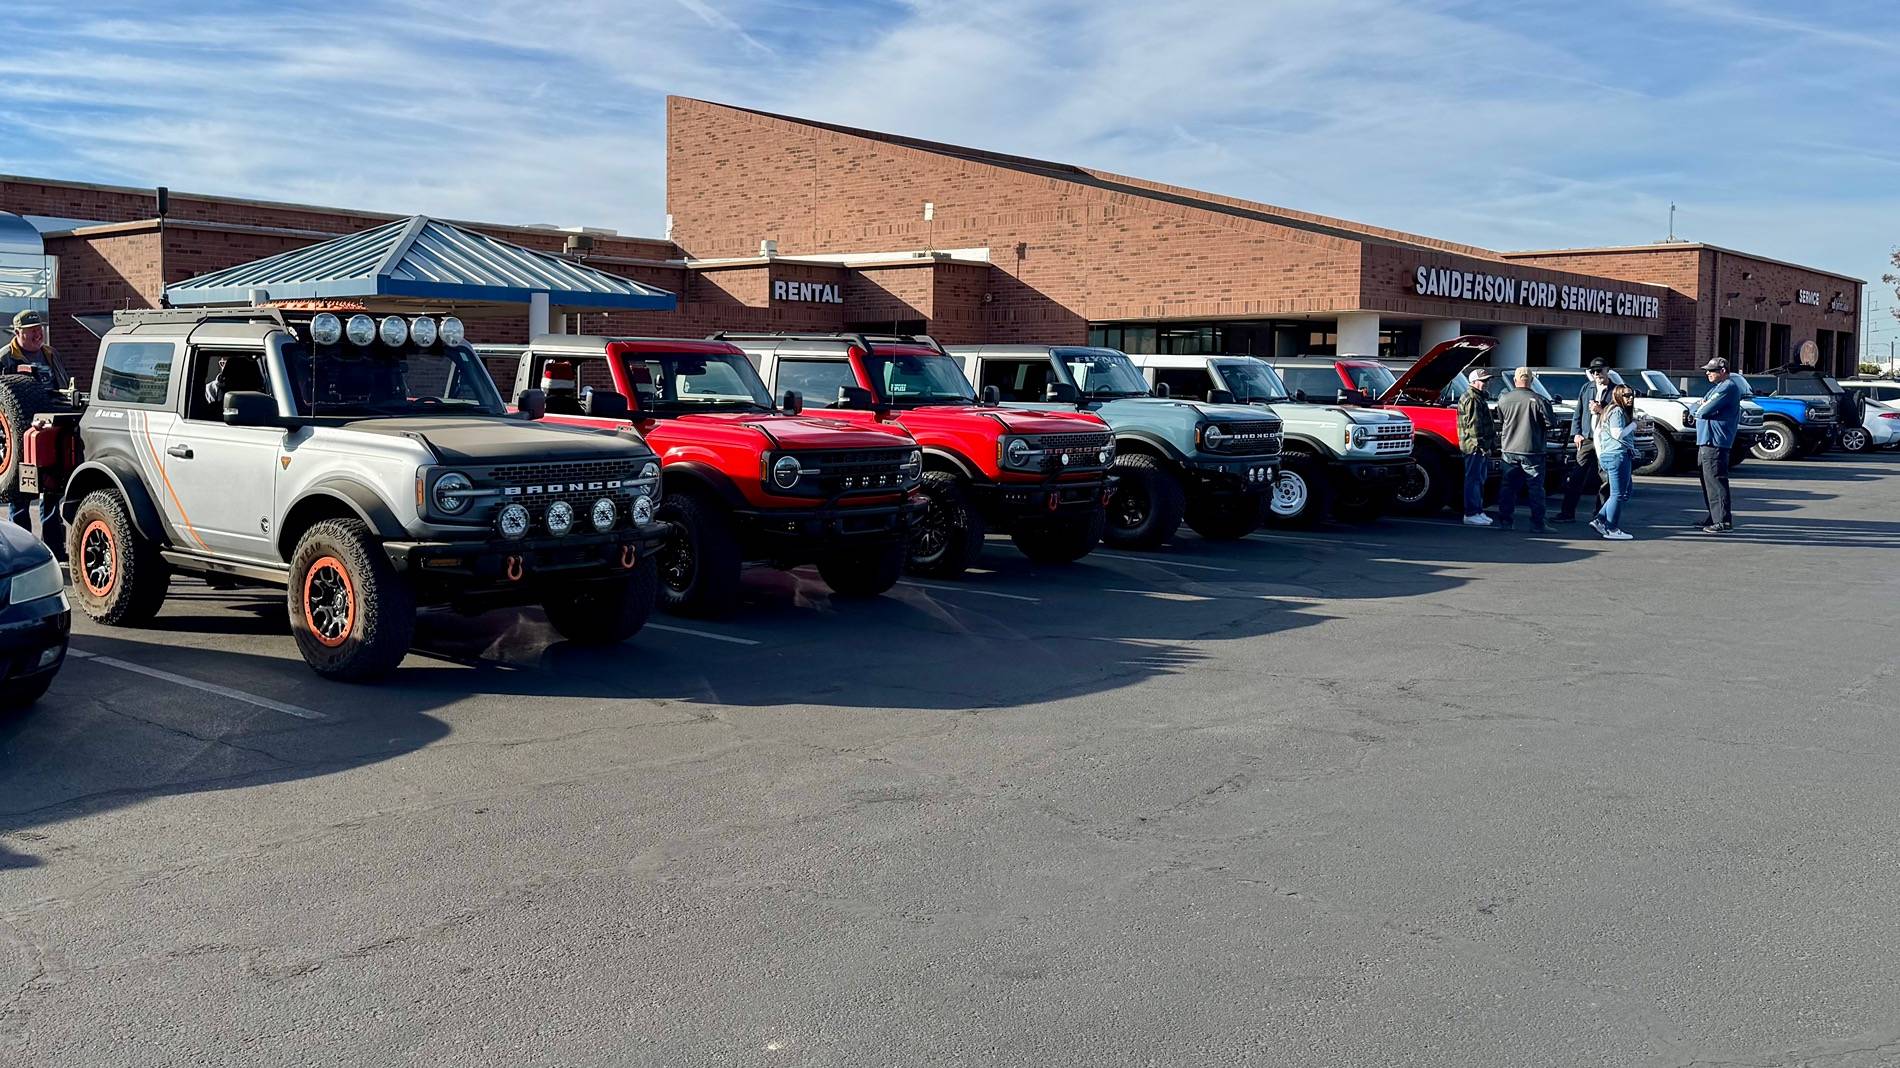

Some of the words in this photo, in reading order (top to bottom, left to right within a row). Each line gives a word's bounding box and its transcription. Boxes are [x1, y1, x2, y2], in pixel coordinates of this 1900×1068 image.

[774, 280, 843, 304] RENTAL
[1415, 265, 1516, 304] SANDERSON
[1519, 280, 1558, 309] FORD
[1561, 286, 1613, 315] SERVICE
[1616, 292, 1660, 319] CENTER
[1799, 288, 1820, 306] SERVICE
[1233, 432, 1276, 440] BRONCO
[504, 480, 621, 496] BRONCO
